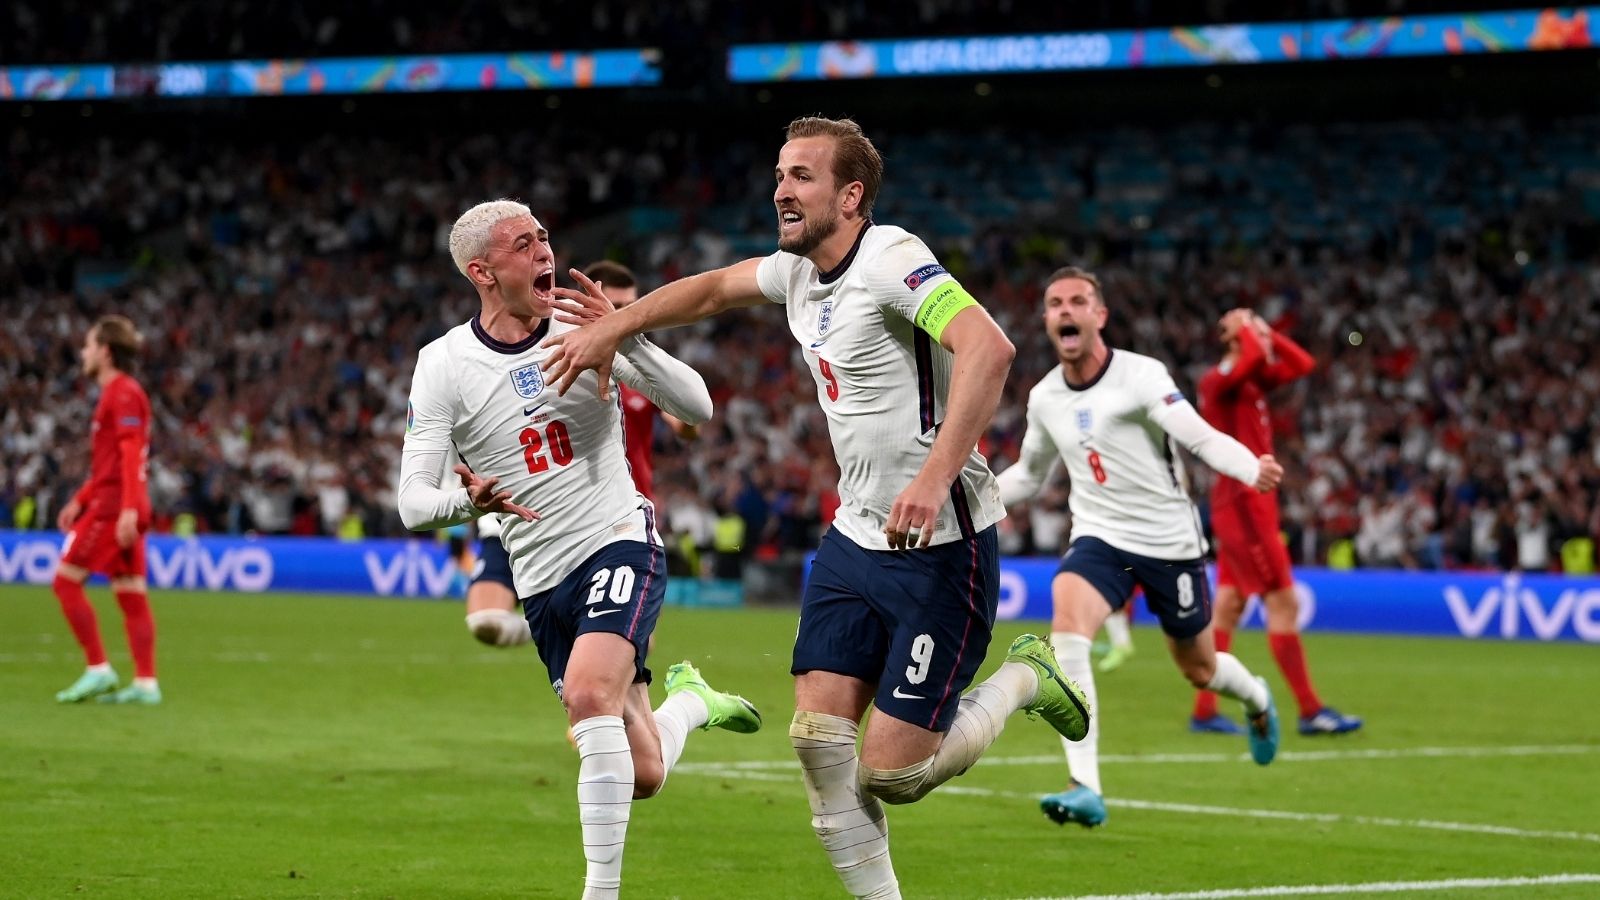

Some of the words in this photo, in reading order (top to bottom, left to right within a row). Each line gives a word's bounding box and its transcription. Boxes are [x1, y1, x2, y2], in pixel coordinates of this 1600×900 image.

[893, 38, 962, 73] UEFA
[967, 36, 1039, 71] EURO
[1043, 33, 1112, 69] 2020
[918, 265, 946, 278] RESPEC
[933, 296, 958, 322] RESPECT
[937, 288, 955, 303] GAME
[818, 357, 839, 402] 9
[519, 419, 574, 474] 20
[1088, 451, 1106, 484] 8
[364, 541, 457, 597] viv
[585, 565, 636, 606] 20
[1177, 571, 1195, 609] 8
[905, 633, 935, 685] 9
